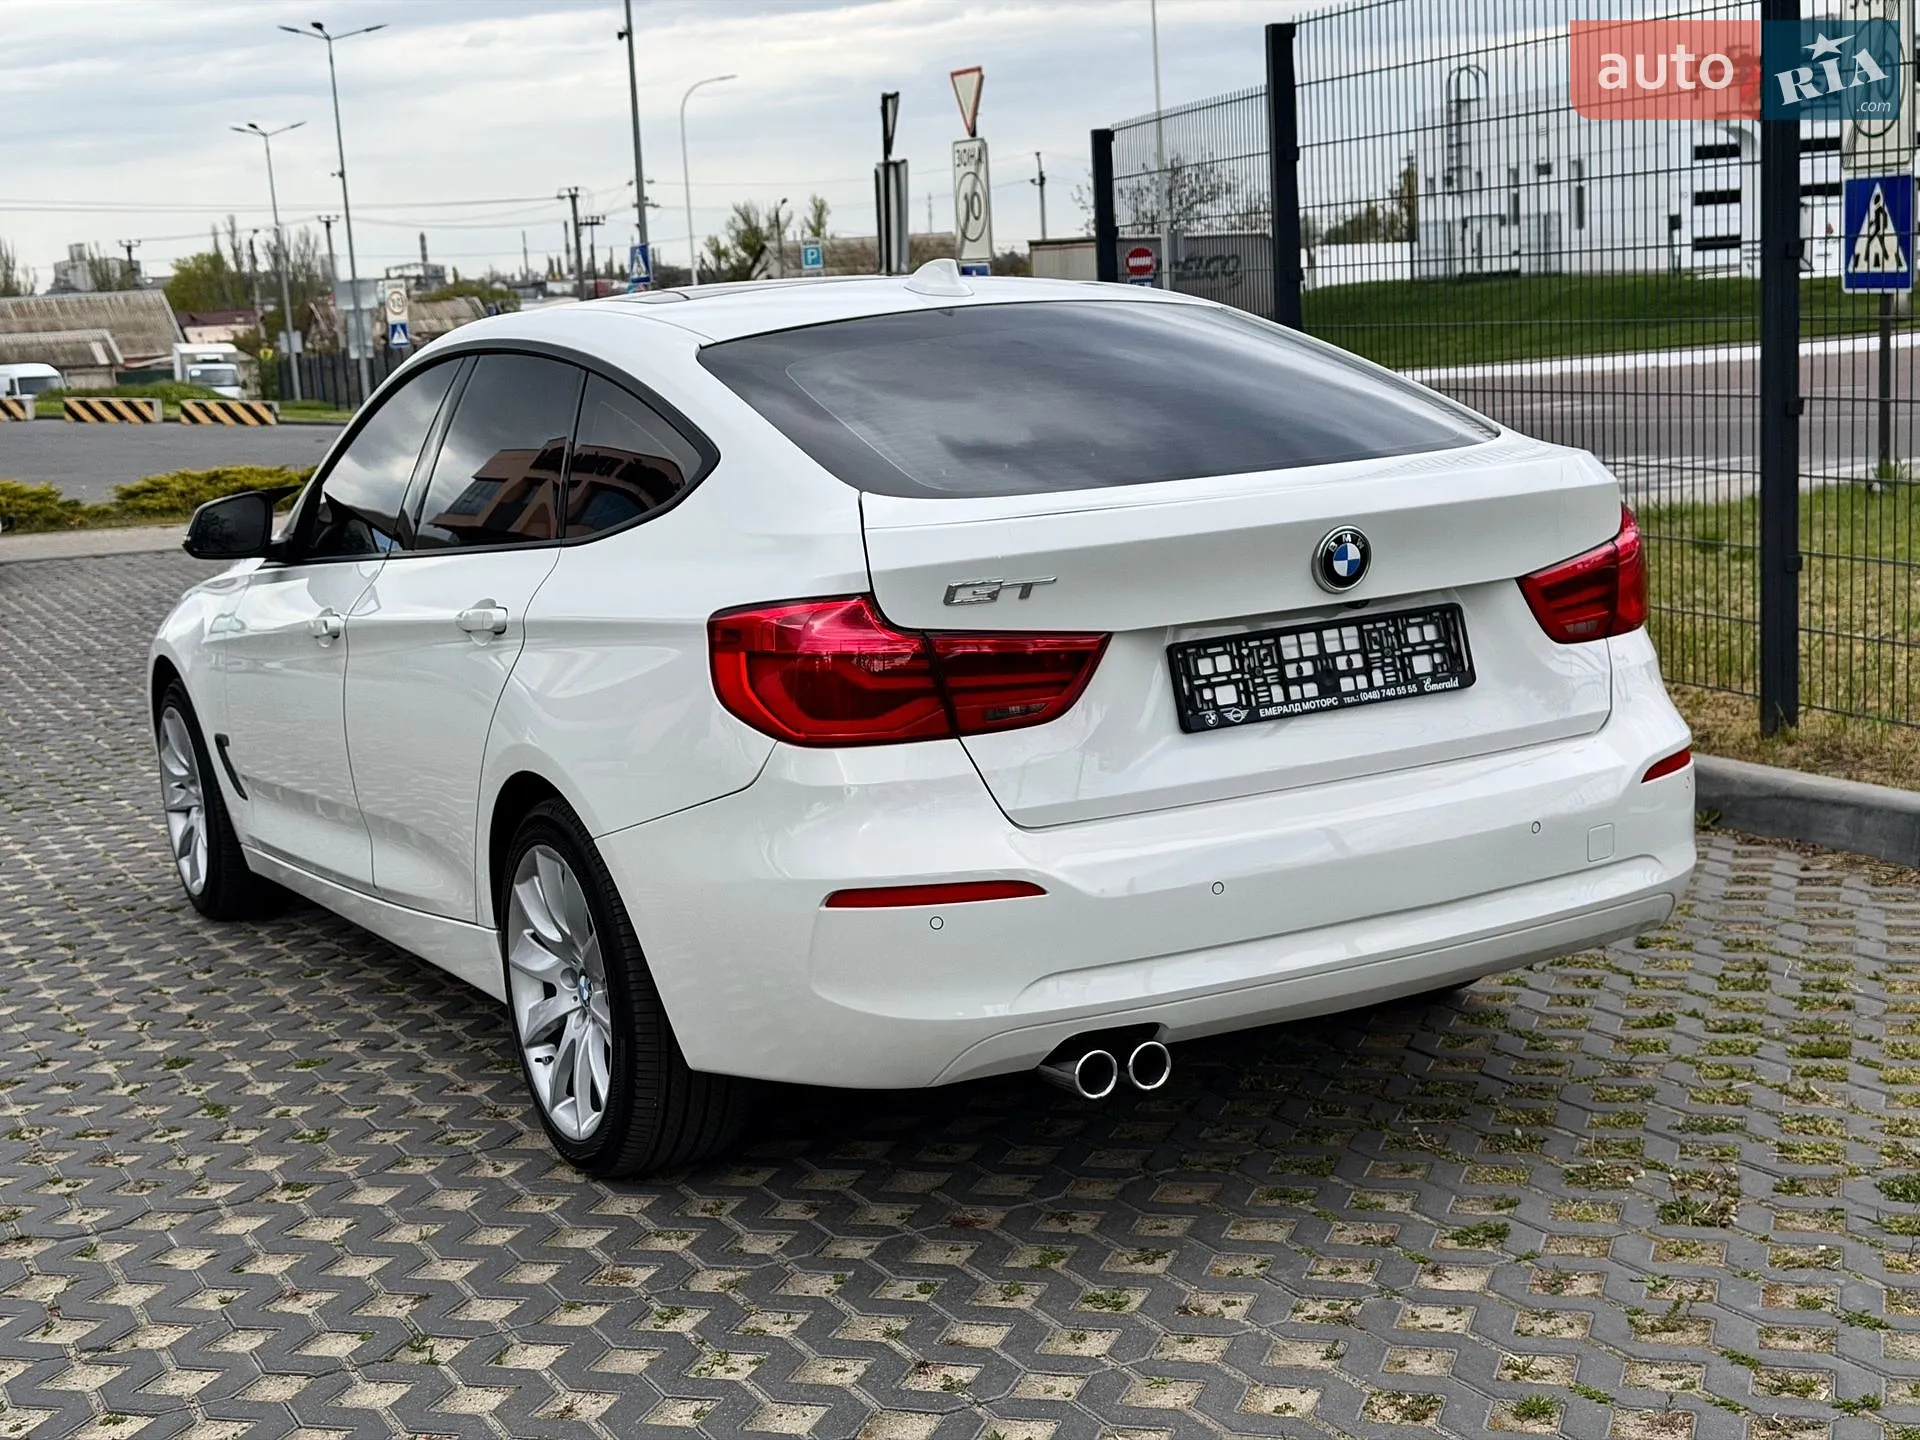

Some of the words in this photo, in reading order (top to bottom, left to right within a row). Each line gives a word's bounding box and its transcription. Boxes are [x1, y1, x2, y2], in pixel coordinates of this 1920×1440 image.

[956, 147, 984, 168] ЗОНА
[963, 191, 982, 222] 10
[1328, 533, 1365, 553] BMW
[943, 576, 1057, 606] GT
[1423, 676, 1459, 692] Emerald
[1259, 703, 1302, 718] ЕМЕРАЛД
[1302, 696, 1339, 711] МОТОРС
[1359, 689, 1380, 702] (048)
[1381, 687, 1396, 698] 740
[1397, 685, 1407, 696] 55
[1407, 683, 1418, 694] 55
